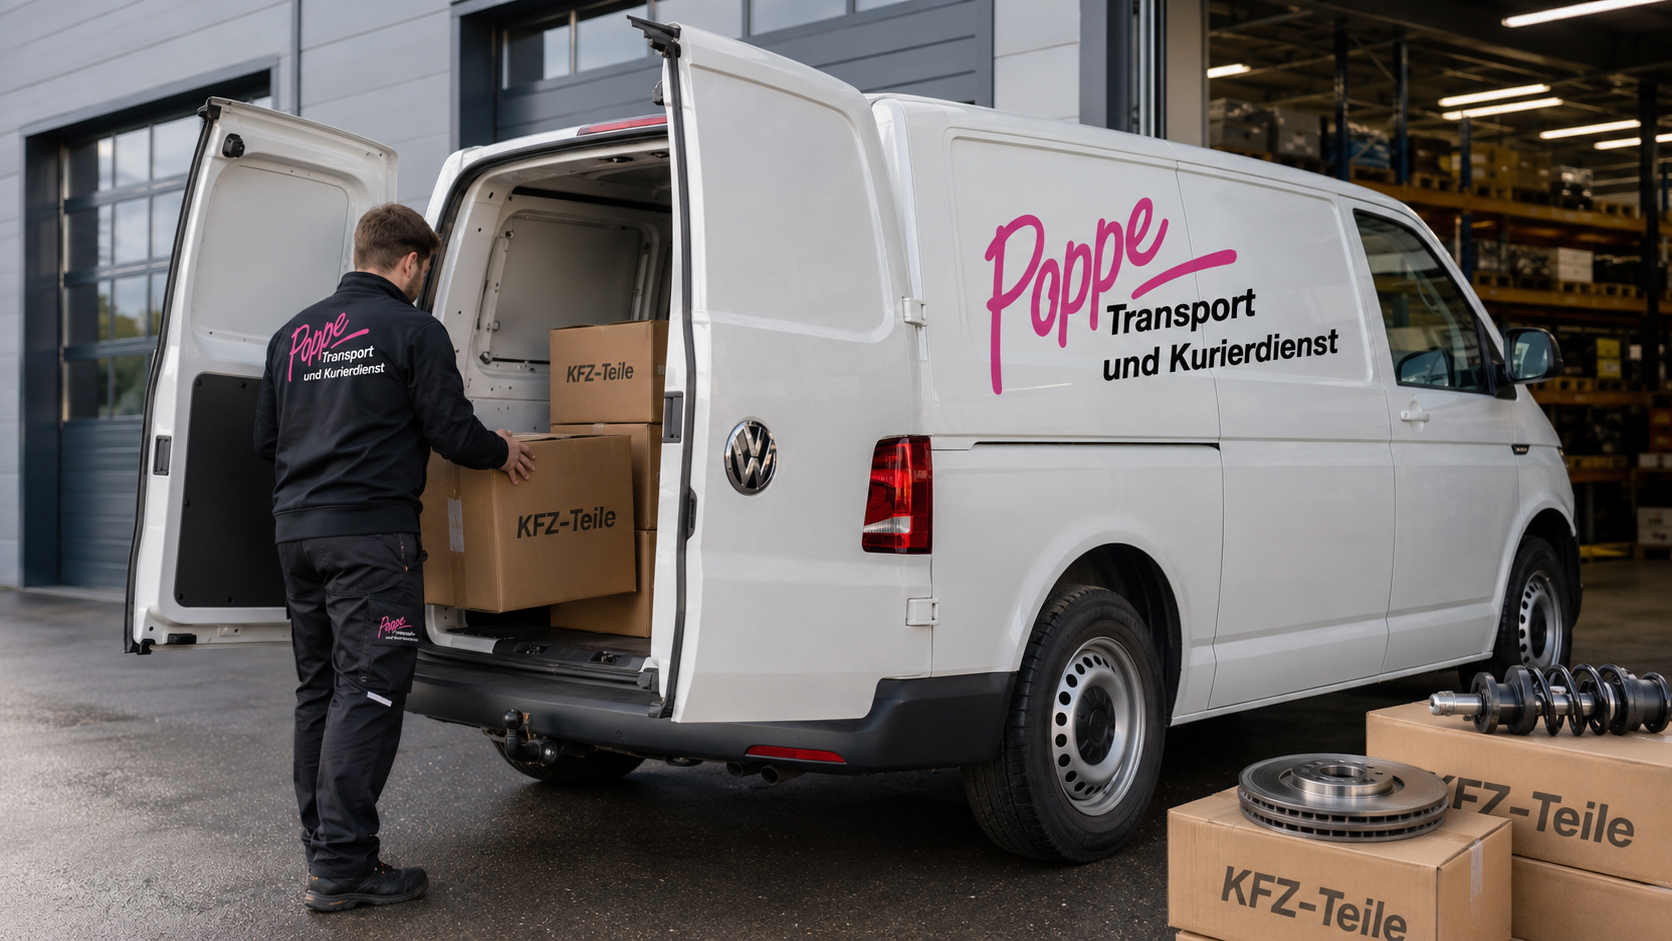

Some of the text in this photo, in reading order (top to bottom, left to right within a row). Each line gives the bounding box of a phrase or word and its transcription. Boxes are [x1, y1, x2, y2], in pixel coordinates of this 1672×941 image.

[985, 197, 1169, 395] Poppe
[1106, 288, 1256, 335] Transport
[288, 312, 350, 382] Poppe
[322, 345, 375, 363] Transport
[1103, 329, 1339, 381] und Kurierdienst
[303, 362, 386, 382] und Kurierdienst
[566, 361, 634, 383] KFZ-Teile
[728, 421, 775, 493] VW
[516, 506, 616, 539] KFZ-Teile
[1221, 865, 1408, 941] KFZ-Teile
